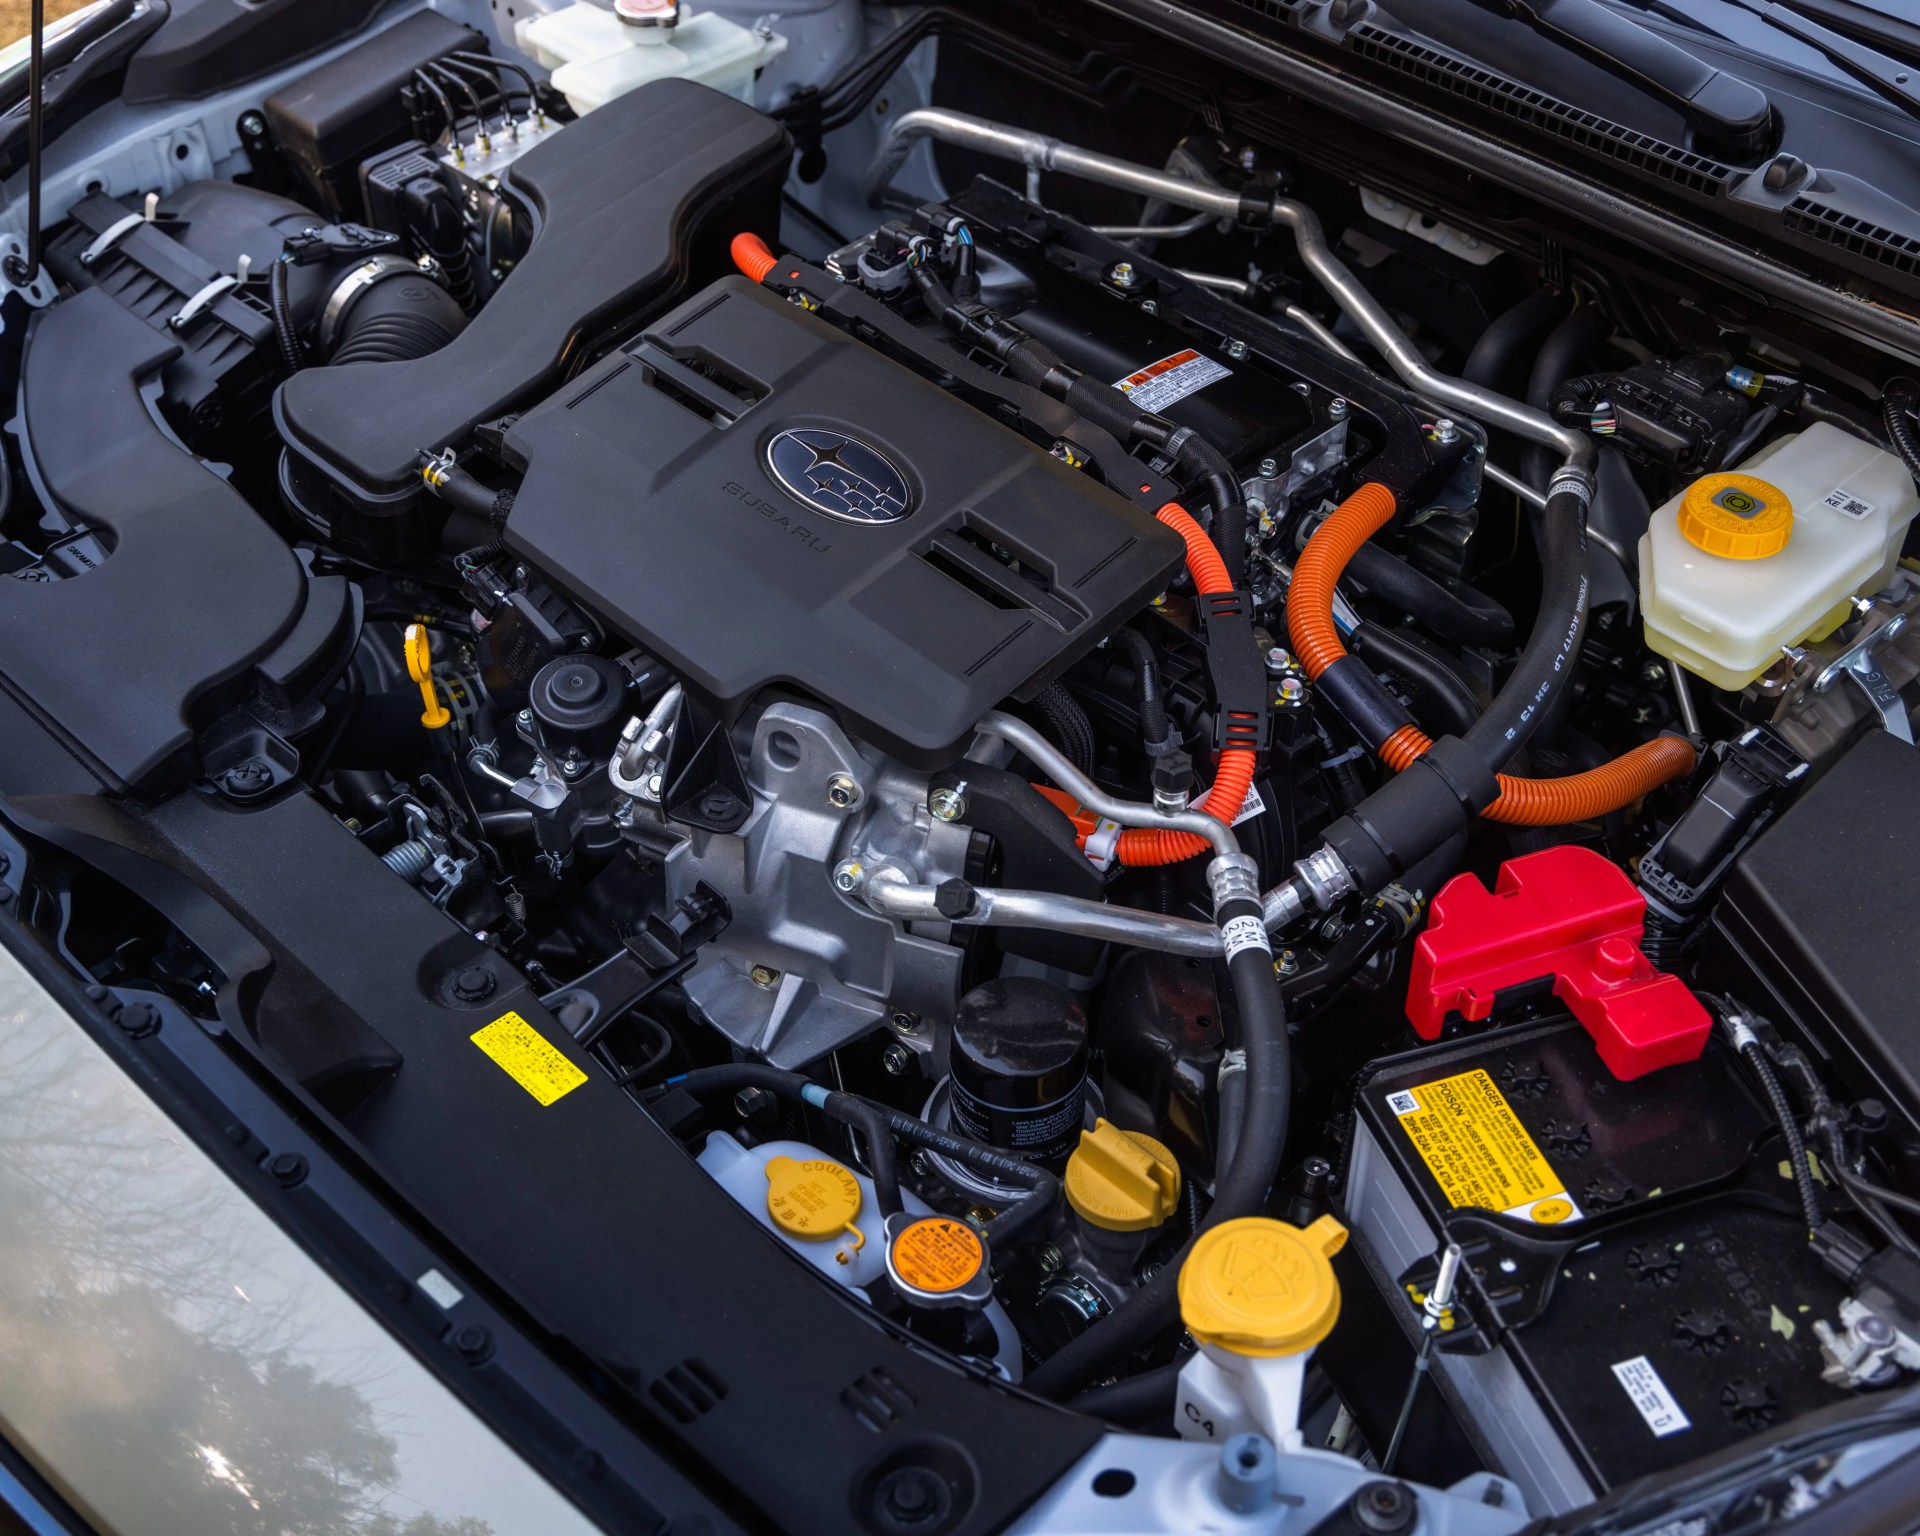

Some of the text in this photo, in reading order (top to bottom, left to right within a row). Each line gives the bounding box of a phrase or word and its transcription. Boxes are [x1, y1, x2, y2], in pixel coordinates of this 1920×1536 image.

[1825, 498, 1841, 508] KE
[722, 481, 832, 553] SUBARU
[1554, 653, 1566, 672] LP
[1417, 1115, 1435, 1133] KEEP
[1472, 1071, 1538, 1161] DANGER EXPLOSIVE GASES
[1427, 1131, 1443, 1145] OUT
[1436, 1082, 1512, 1189] POISON CAUSES SEVERE BURNS
[1402, 1114, 1423, 1135] 20HR
[1414, 1133, 1434, 1153] 62Ah
[1426, 1153, 1446, 1172] CCA
[1436, 1169, 1456, 1189] 470A
[1426, 1112, 1444, 1130] KEEP
[1437, 1128, 1454, 1145] VENT
[1446, 1144, 1464, 1162] CAPS
[1457, 1160, 1476, 1180] TIGHT
[1469, 1178, 1484, 1193] AND
[1435, 1143, 1449, 1154] OF
[1441, 1153, 1461, 1175] REACH
[802, 1161, 858, 1208] COOLANT
[1454, 1173, 1467, 1185] OF
